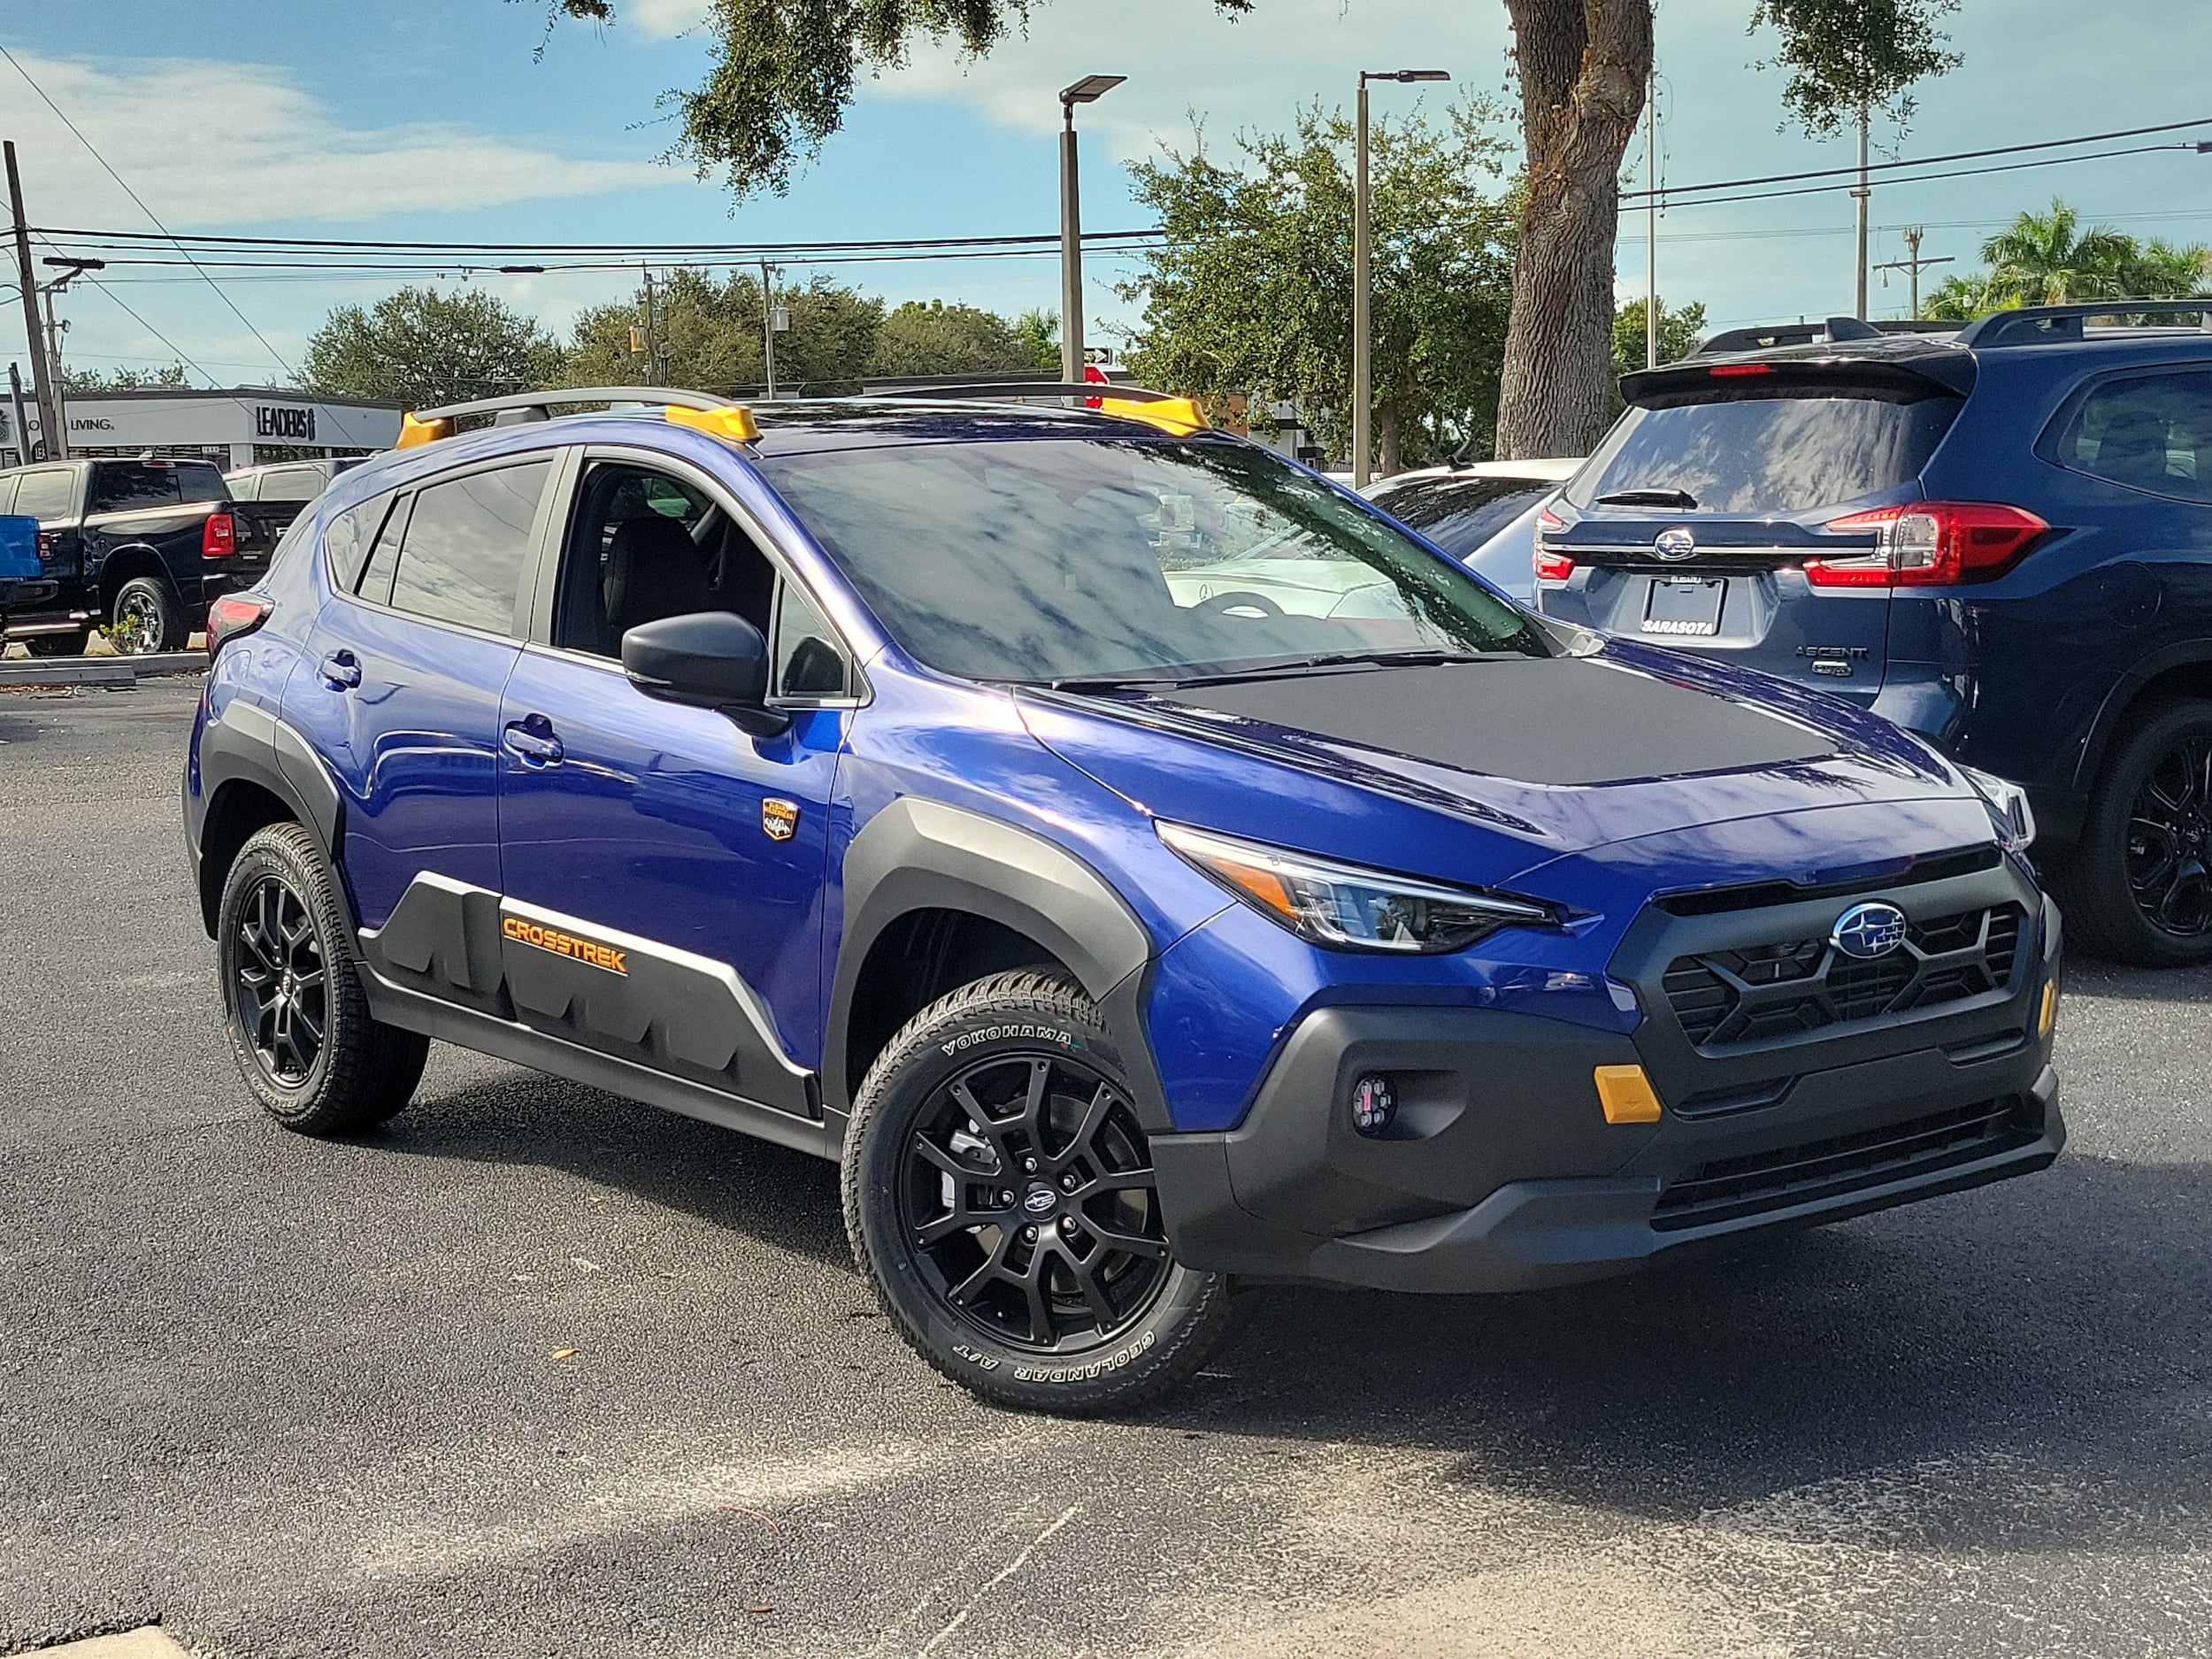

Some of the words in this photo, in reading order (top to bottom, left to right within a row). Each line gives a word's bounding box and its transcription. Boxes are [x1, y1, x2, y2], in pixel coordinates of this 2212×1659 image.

[256, 406, 307, 438] LEADERS
[1640, 619, 1714, 635] SARASOTA
[1795, 646, 1868, 657] ASCENT
[503, 918, 627, 973] CROSSTREK
[941, 1025, 1072, 1056] YOKOHAMA
[1013, 1330, 1156, 1382] GEOLANDAR
